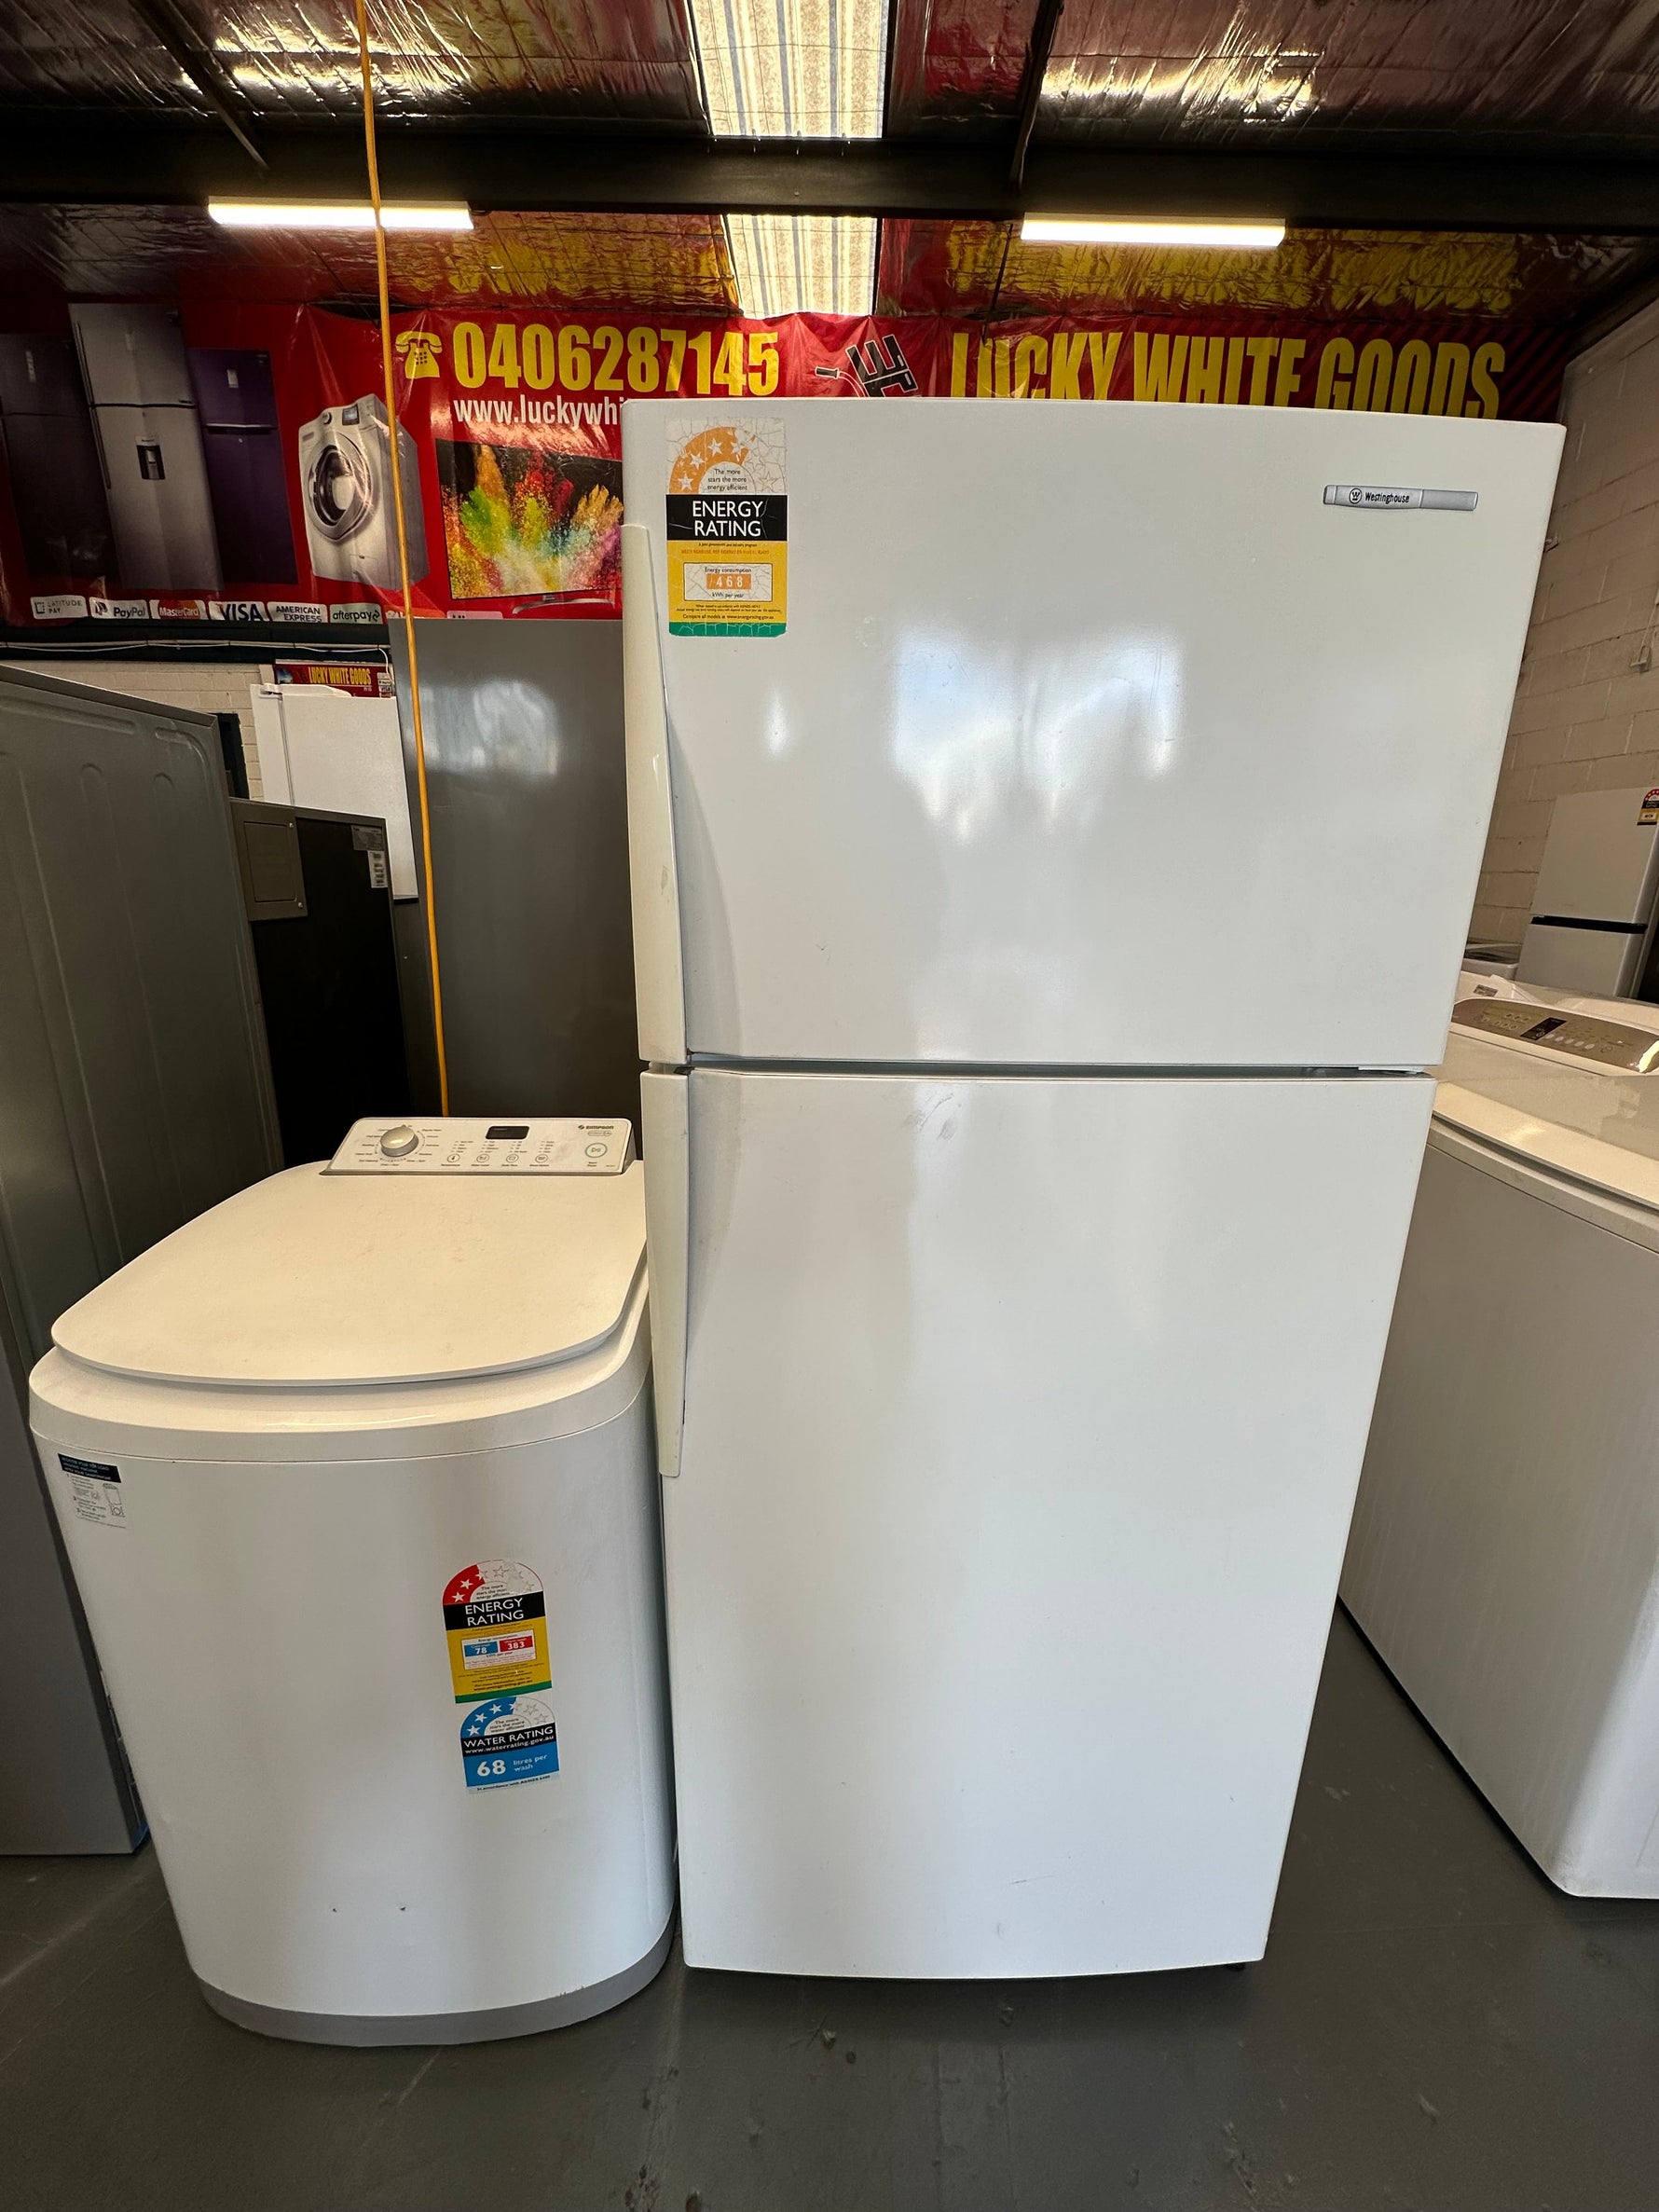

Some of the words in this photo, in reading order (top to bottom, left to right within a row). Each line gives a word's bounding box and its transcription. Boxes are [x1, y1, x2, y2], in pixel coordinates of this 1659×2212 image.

[452, 322, 779, 396] 0406287145
[1364, 492, 1410, 504] Westinghouse
[692, 501, 763, 517] ENERGY
[694, 520, 761, 537] RATING
[48, 599, 82, 608] LATITUDE
[114, 607, 145, 619] PayPal
[159, 608, 199, 617] MasterCard
[221, 604, 263, 621] VISA
[276, 606, 321, 615] AMERICAN
[332, 610, 372, 623] afterpay
[283, 613, 322, 623] EXPRESS
[308, 666, 328, 684] LUCKY
[328, 667, 350, 685] WHITE
[350, 667, 371, 685] GOODS
[465, 1598, 524, 1614] ENERGY
[467, 1610, 525, 1627] RATING
[475, 1647, 487, 1656] 78
[507, 1641, 526, 1650] 383
[464, 1736, 505, 1748] WATER
[509, 1726, 554, 1742] RATING
[534, 1754, 548, 1764] per
[477, 1760, 506, 1777] 68
[514, 1764, 533, 1772] wash
